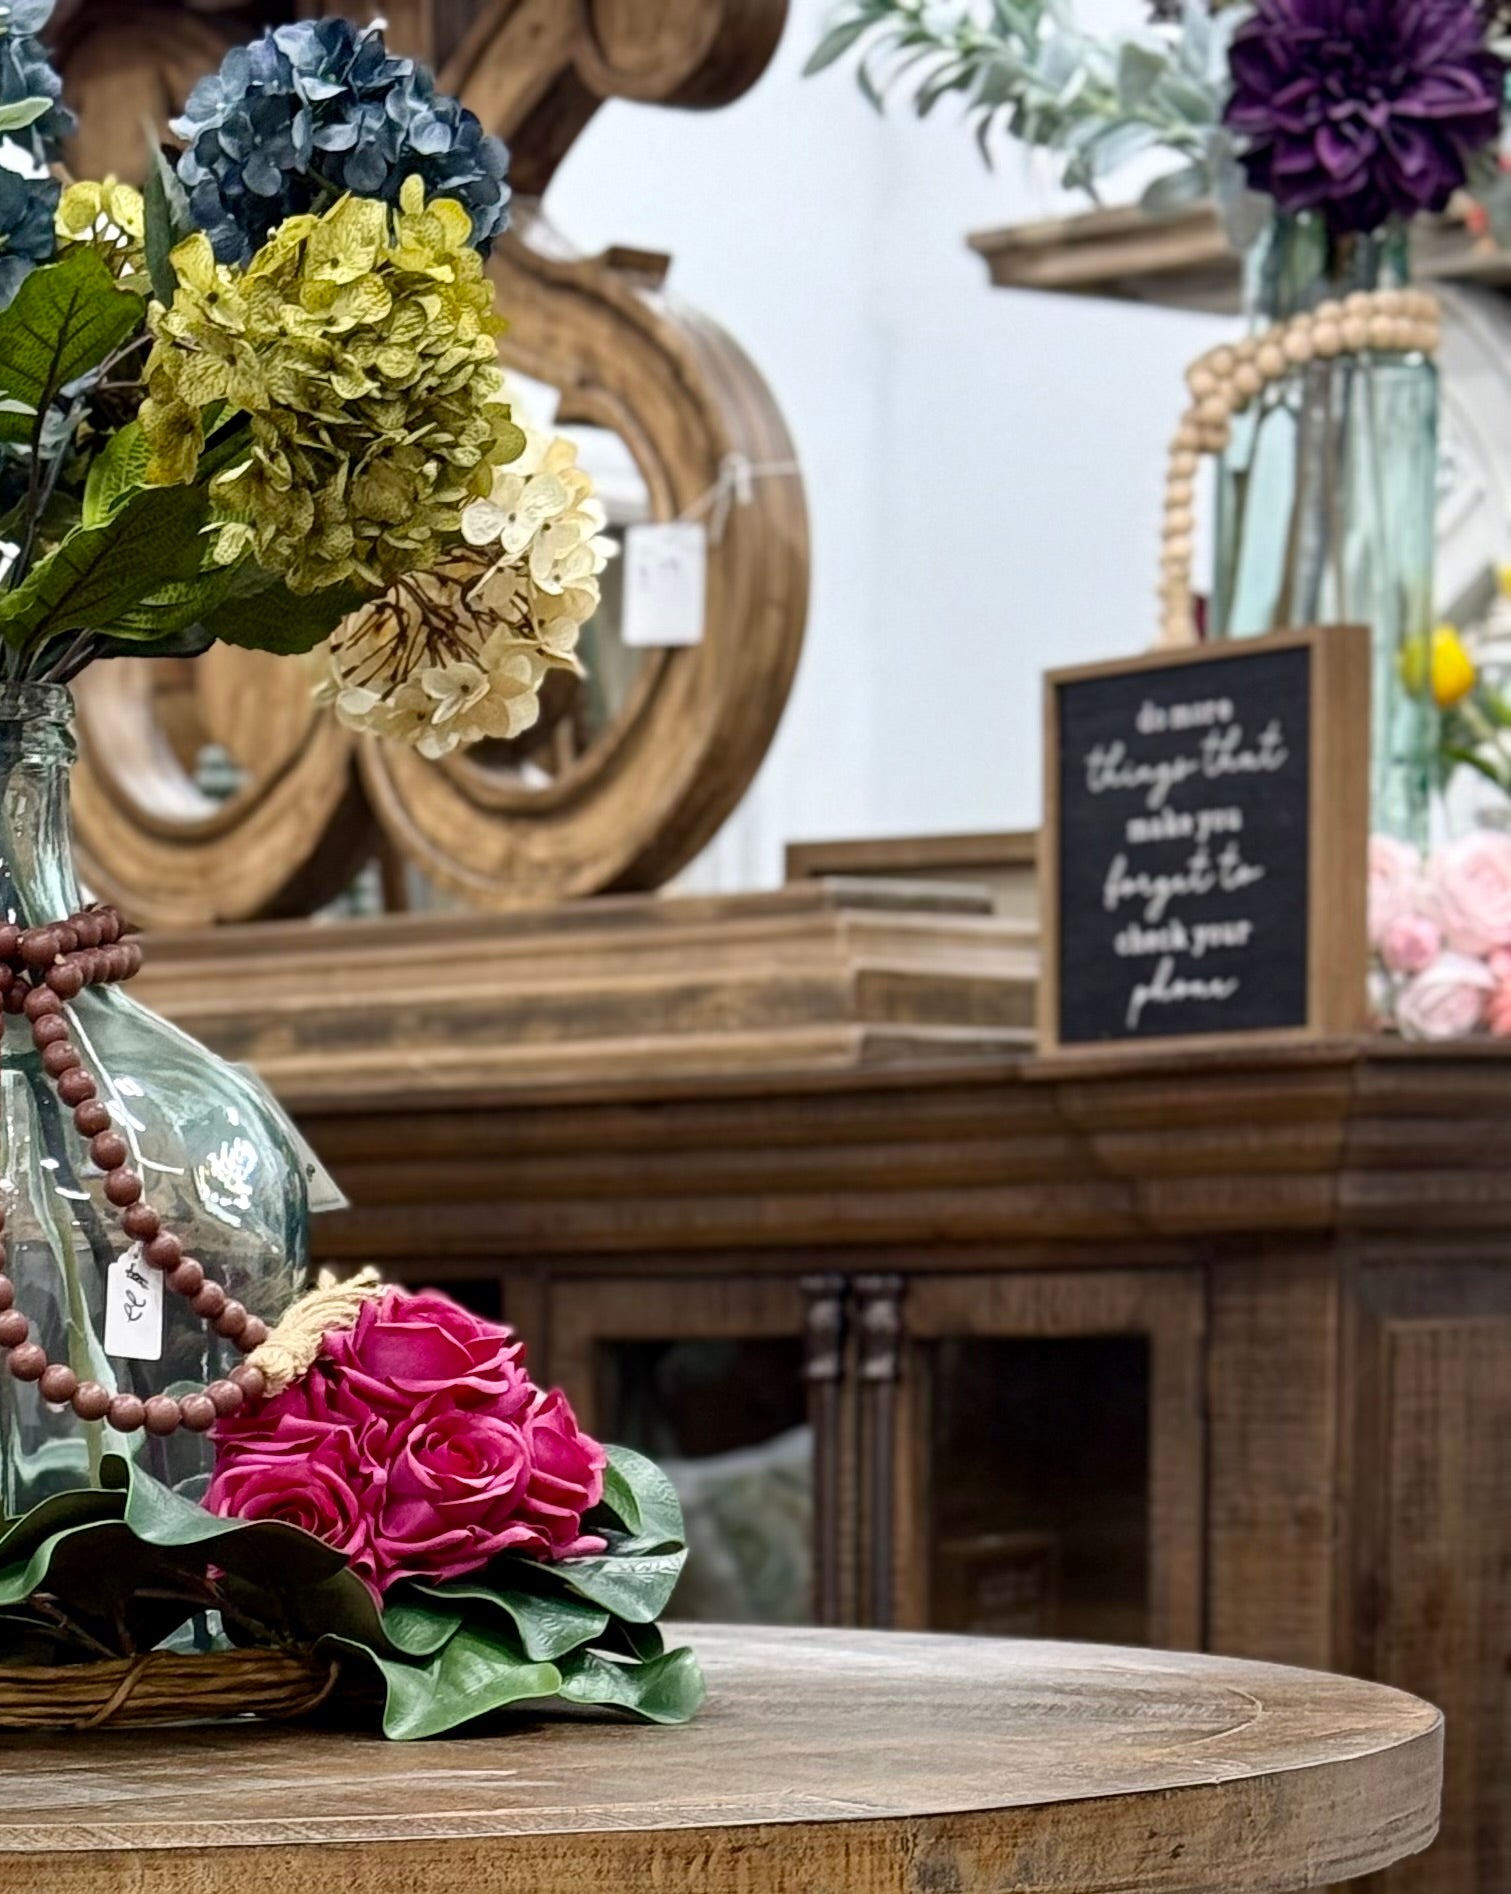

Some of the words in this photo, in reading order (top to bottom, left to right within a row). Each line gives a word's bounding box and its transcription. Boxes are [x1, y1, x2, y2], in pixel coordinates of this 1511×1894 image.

[1136, 698, 1168, 735] do
[1169, 697, 1234, 731] more
[1085, 738, 1200, 811] things
[1199, 718, 1289, 779] that
[1125, 805, 1194, 844] make
[1195, 806, 1243, 844] you
[1102, 846, 1216, 923] forget
[1217, 841, 1266, 892] to
[1113, 918, 1189, 956] check
[1190, 919, 1253, 958] your
[1125, 955, 1240, 1030] phone
